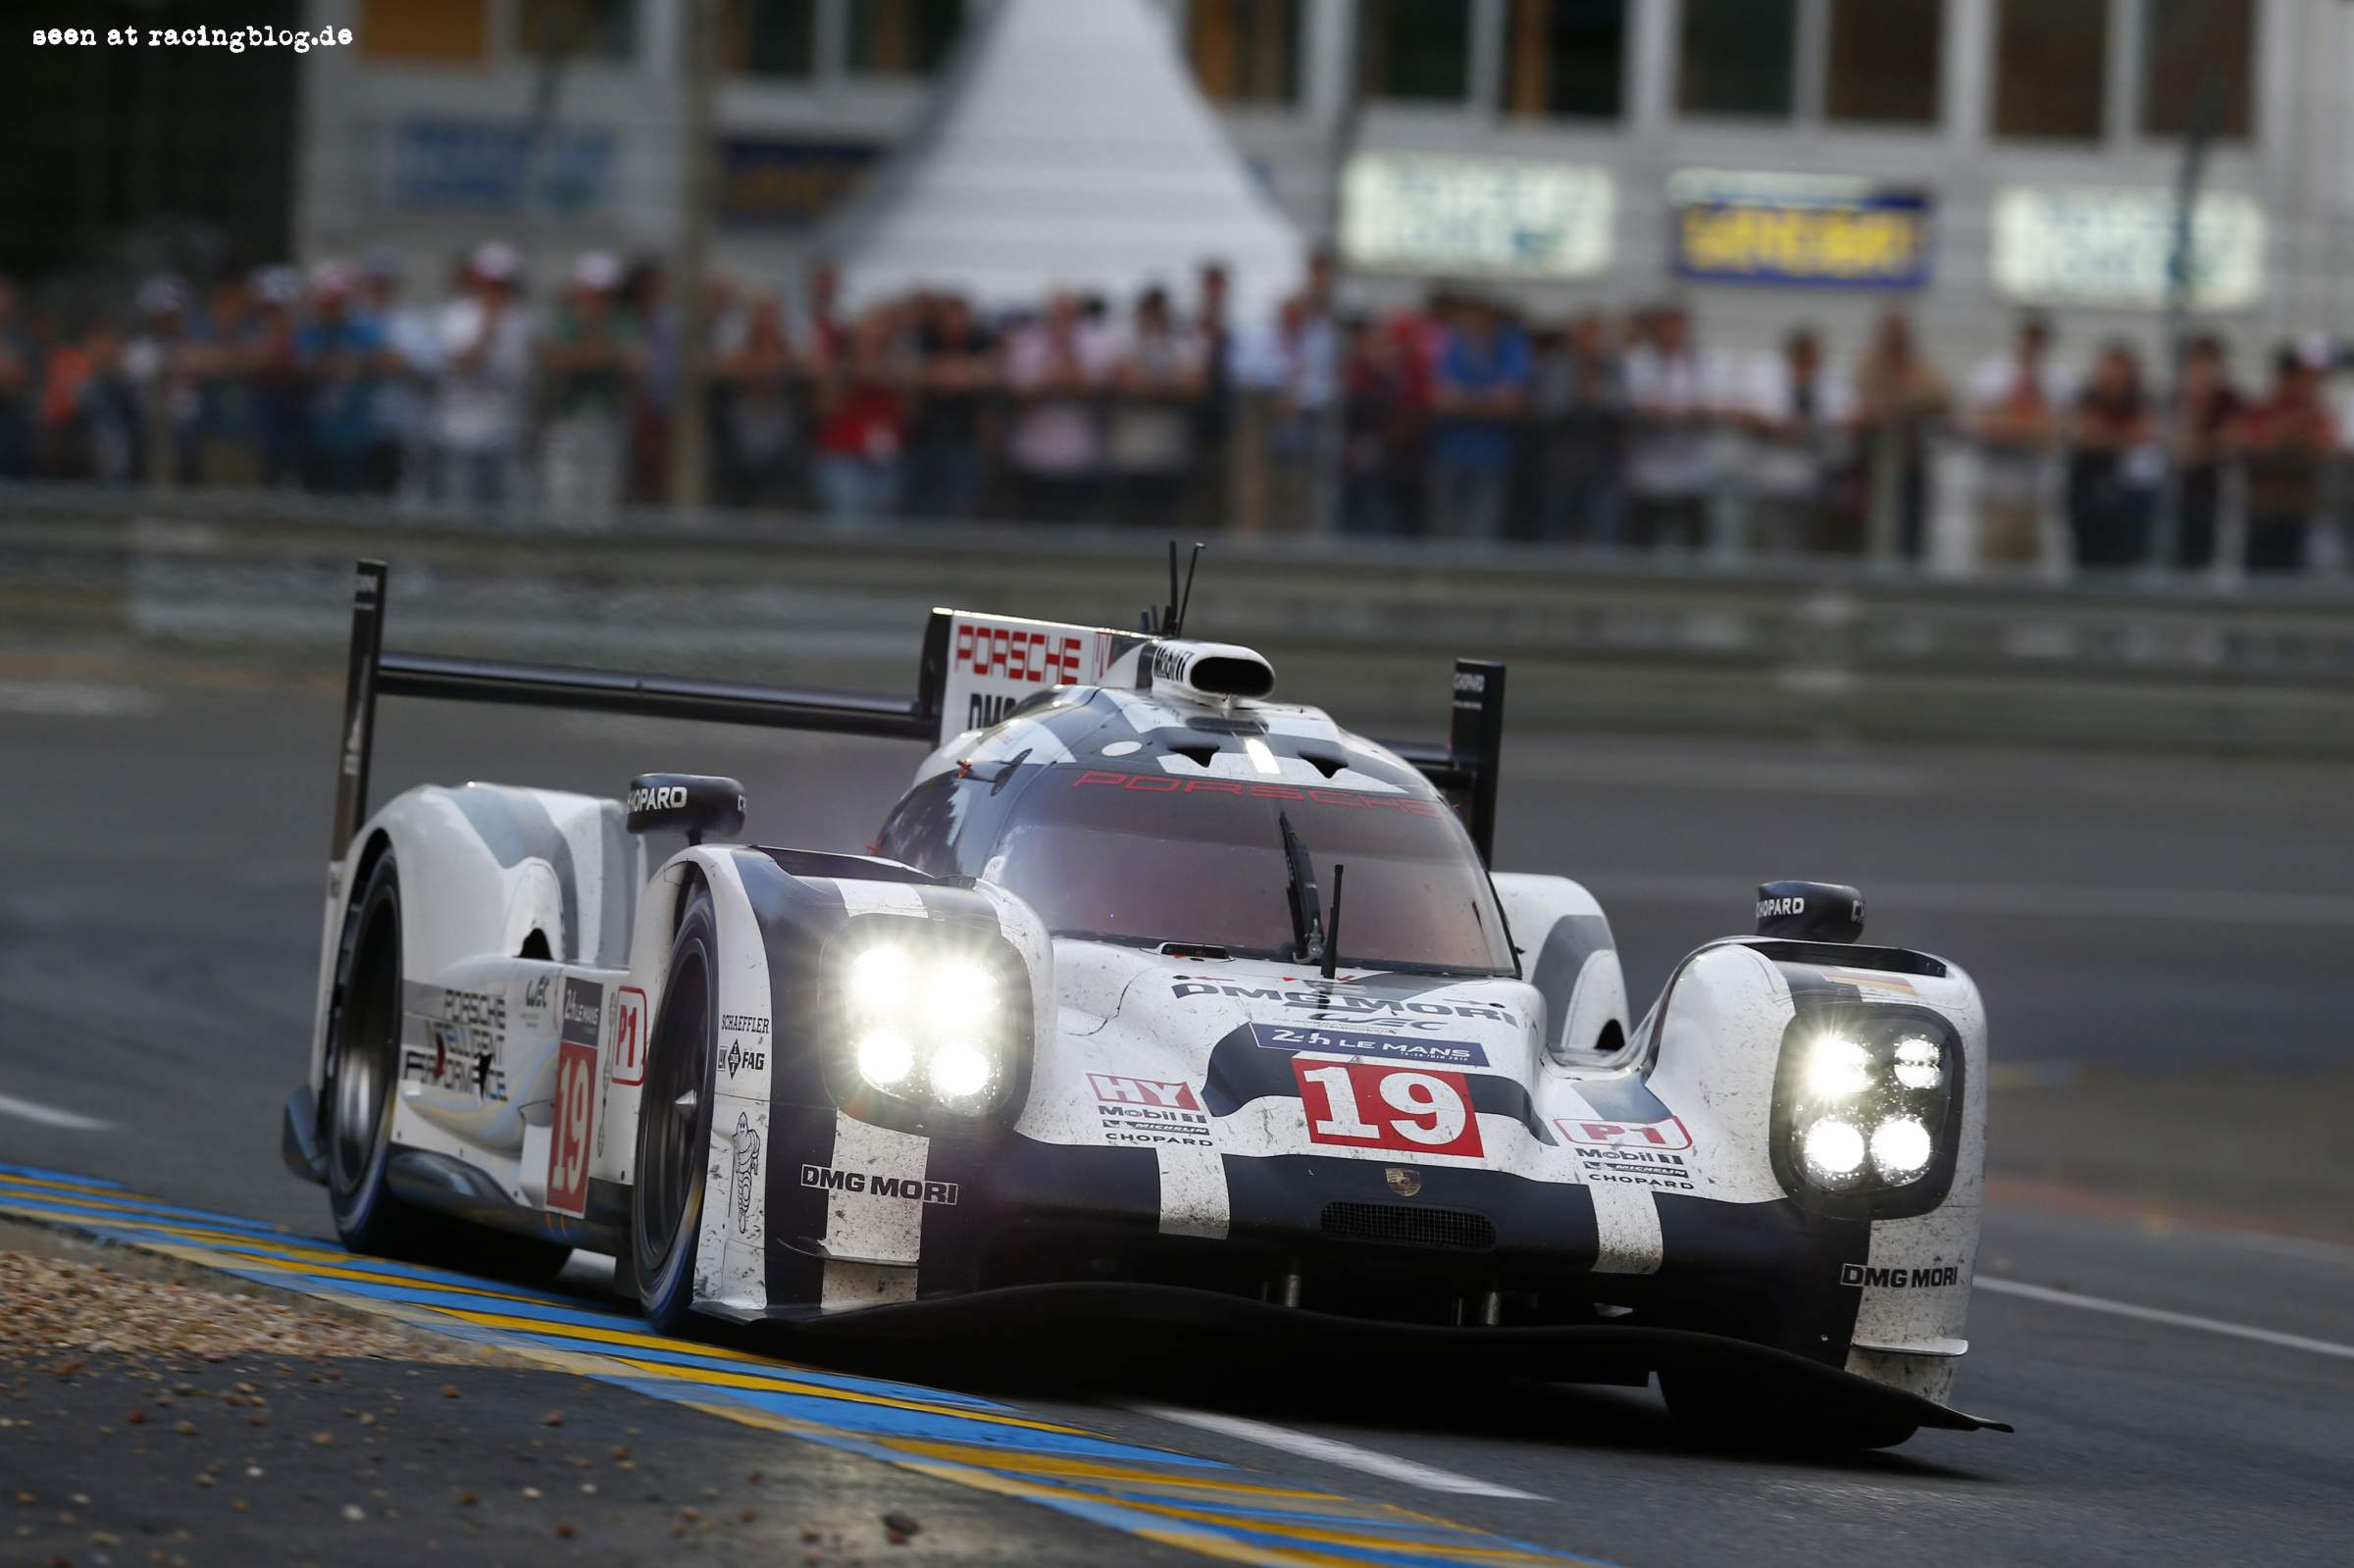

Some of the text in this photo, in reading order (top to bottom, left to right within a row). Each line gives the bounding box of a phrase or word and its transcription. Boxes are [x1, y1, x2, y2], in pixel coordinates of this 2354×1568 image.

[955, 625, 1082, 684] PORSCHE
[1074, 771, 1441, 818] PORSCHE
[442, 988, 507, 1031] PORSCHE
[1171, 984, 1334, 1004] DMG
[1342, 995, 1520, 1029] MORI
[615, 1004, 640, 1069] P1
[721, 1014, 770, 1035] SCHAEFFLER
[742, 1051, 765, 1071] FAG
[1339, 1039, 1375, 1050] LE
[1382, 1042, 1471, 1058] MANS
[1088, 1074, 1187, 1107] HY
[1098, 1105, 1178, 1122] Mobil
[1303, 1066, 1466, 1145] 19
[550, 1056, 589, 1194] 19
[1579, 1123, 1667, 1145] P1
[1105, 1133, 1214, 1147] CHOPARD
[1574, 1147, 1655, 1162] Mobil
[801, 1165, 958, 1205] DMG MORI
[1589, 1174, 1695, 1190] CHOPARD
[1842, 1264, 1959, 1289] DMG MORI
